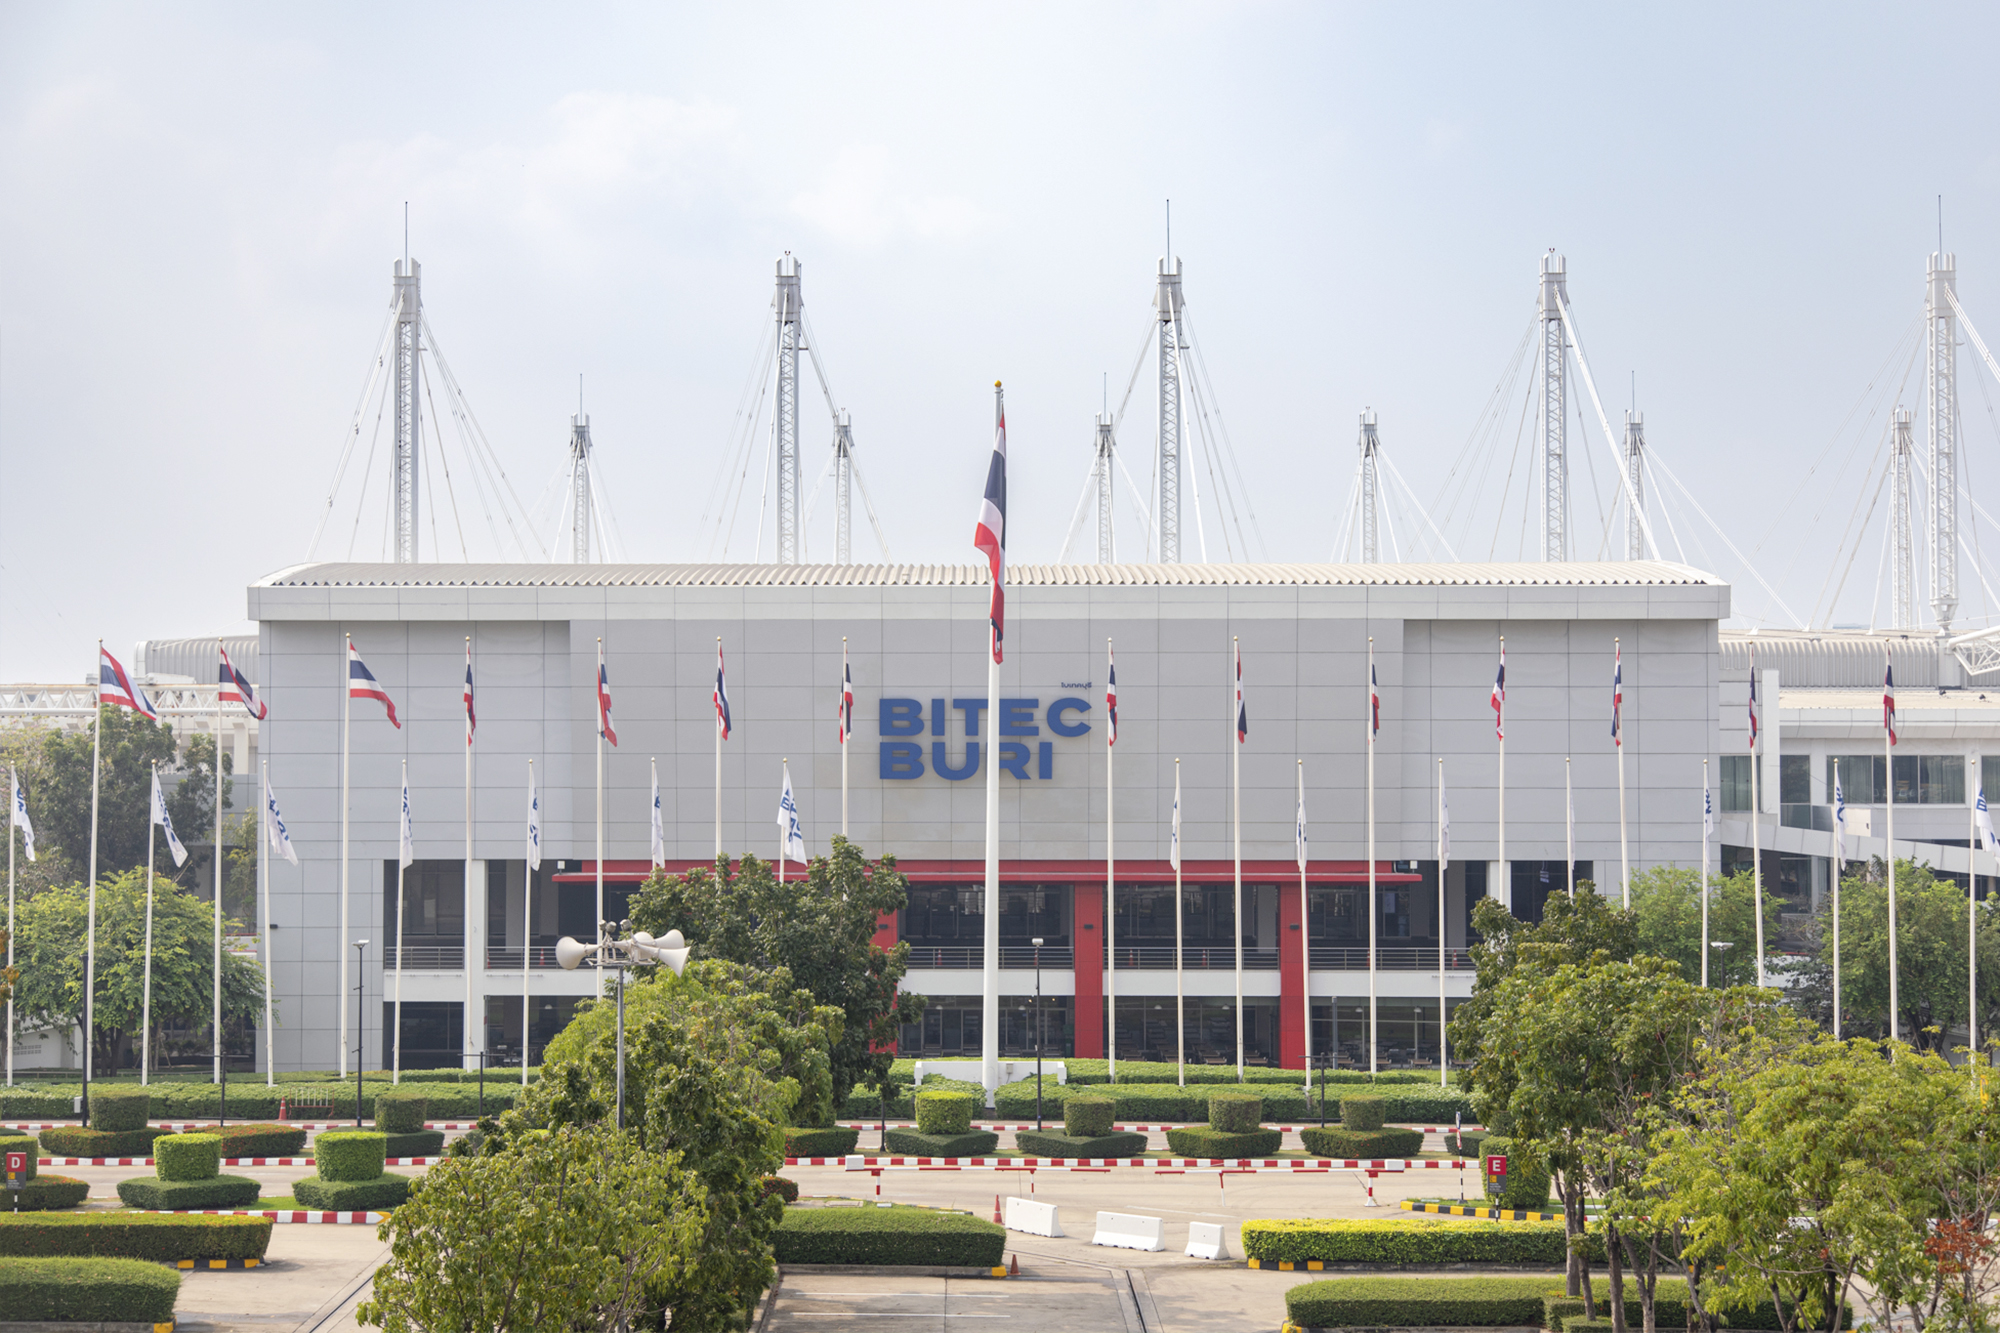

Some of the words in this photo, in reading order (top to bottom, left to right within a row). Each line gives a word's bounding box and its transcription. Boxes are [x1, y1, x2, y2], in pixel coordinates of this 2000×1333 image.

[879, 697, 1092, 737] BITEC
[879, 741, 1053, 781] BURI
[11, 1157, 21, 1169] D
[1492, 1160, 1501, 1172] E
